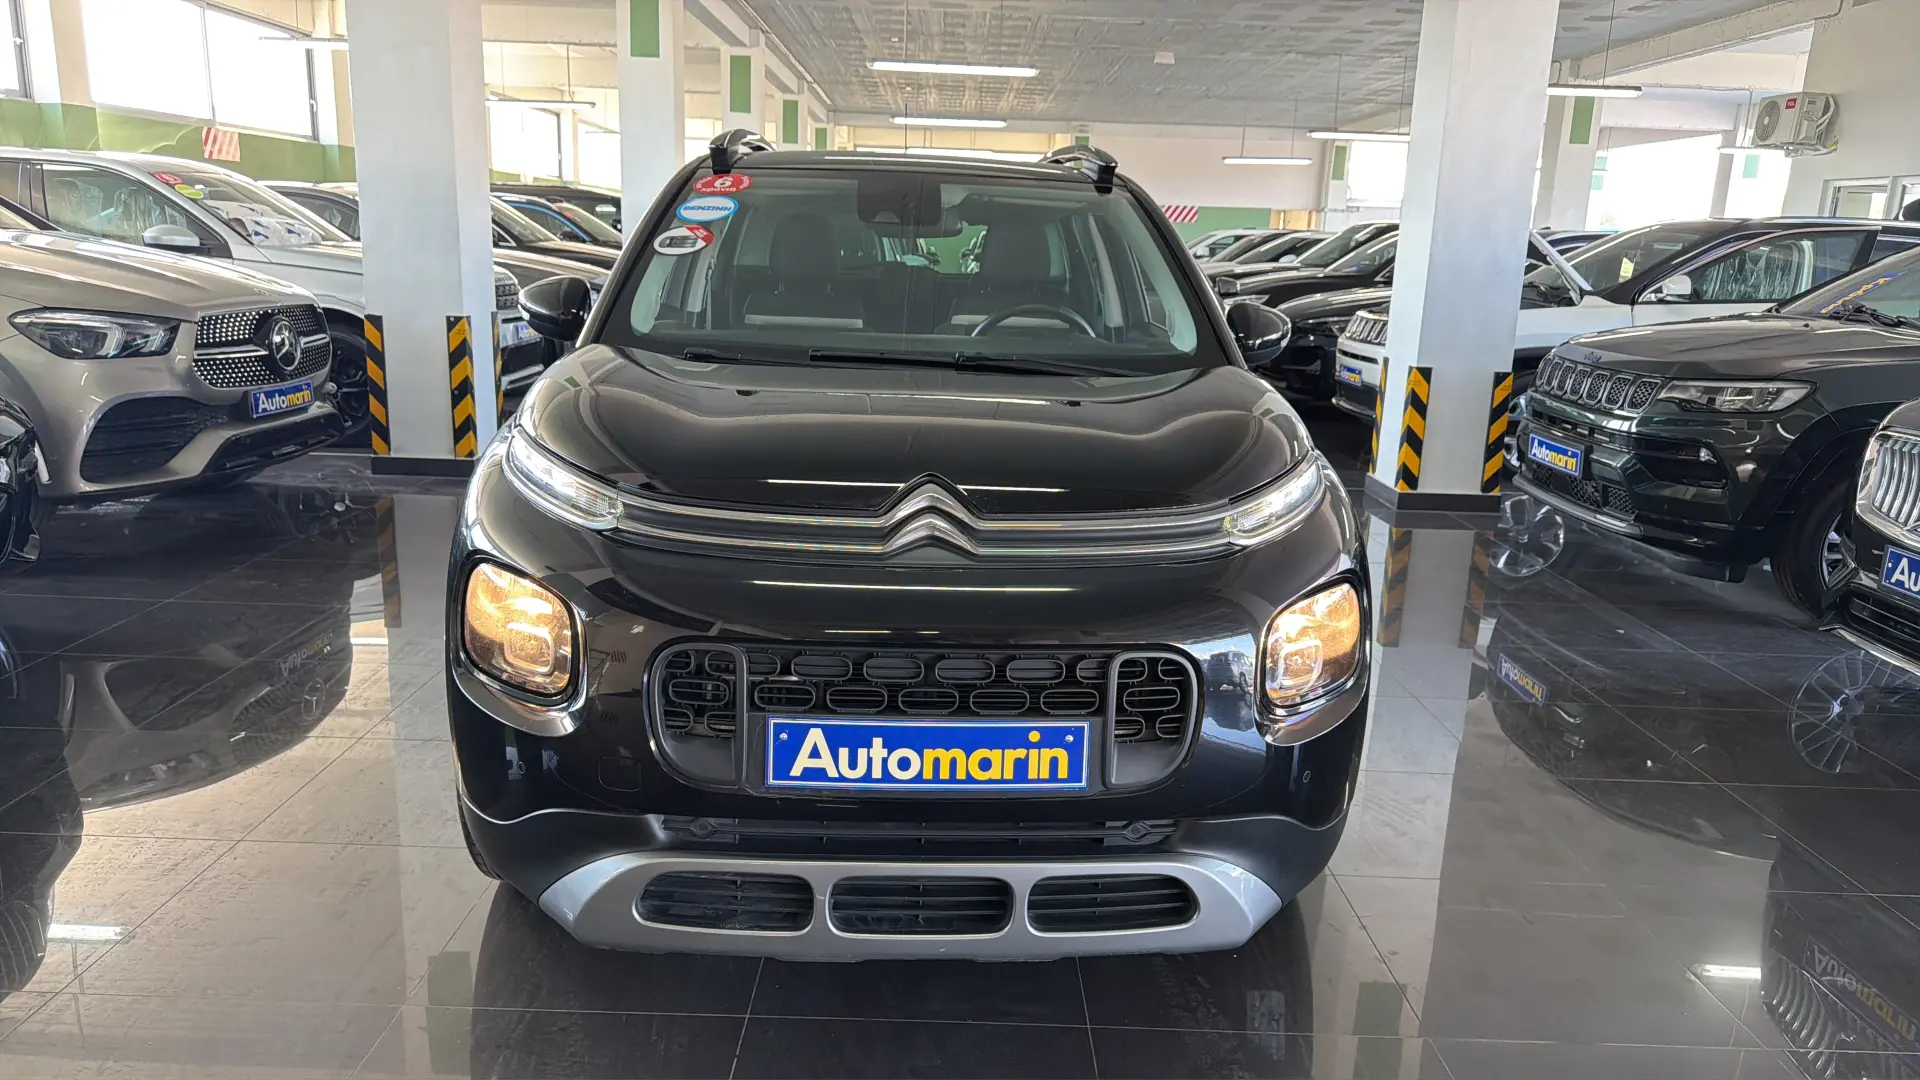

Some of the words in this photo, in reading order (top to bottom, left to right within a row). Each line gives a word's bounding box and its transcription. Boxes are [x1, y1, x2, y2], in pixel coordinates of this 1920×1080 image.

[713, 177, 734, 188] 6
[258, 384, 312, 413] Automarin
[1531, 438, 1577, 471] Automarin
[789, 727, 1068, 780] Automarin
